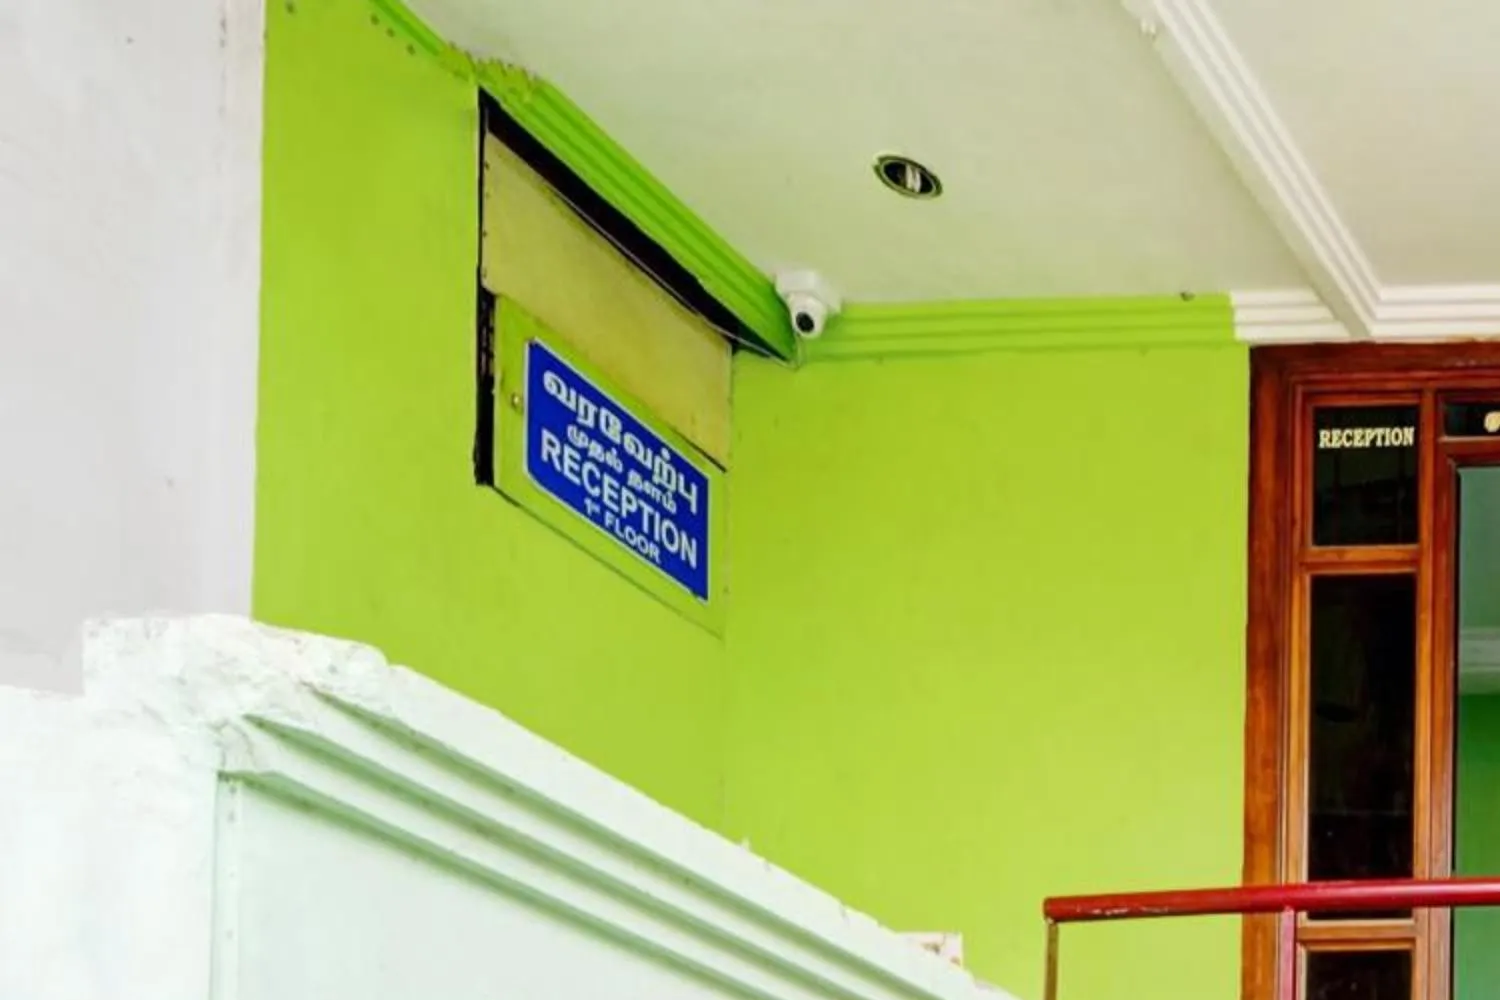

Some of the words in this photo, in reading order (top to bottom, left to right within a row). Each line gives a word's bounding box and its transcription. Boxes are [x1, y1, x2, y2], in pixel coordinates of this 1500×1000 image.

[1319, 426, 1414, 448] RECEPTION
[541, 428, 697, 569] RECEPTION
[605, 511, 661, 563] FLOOR
